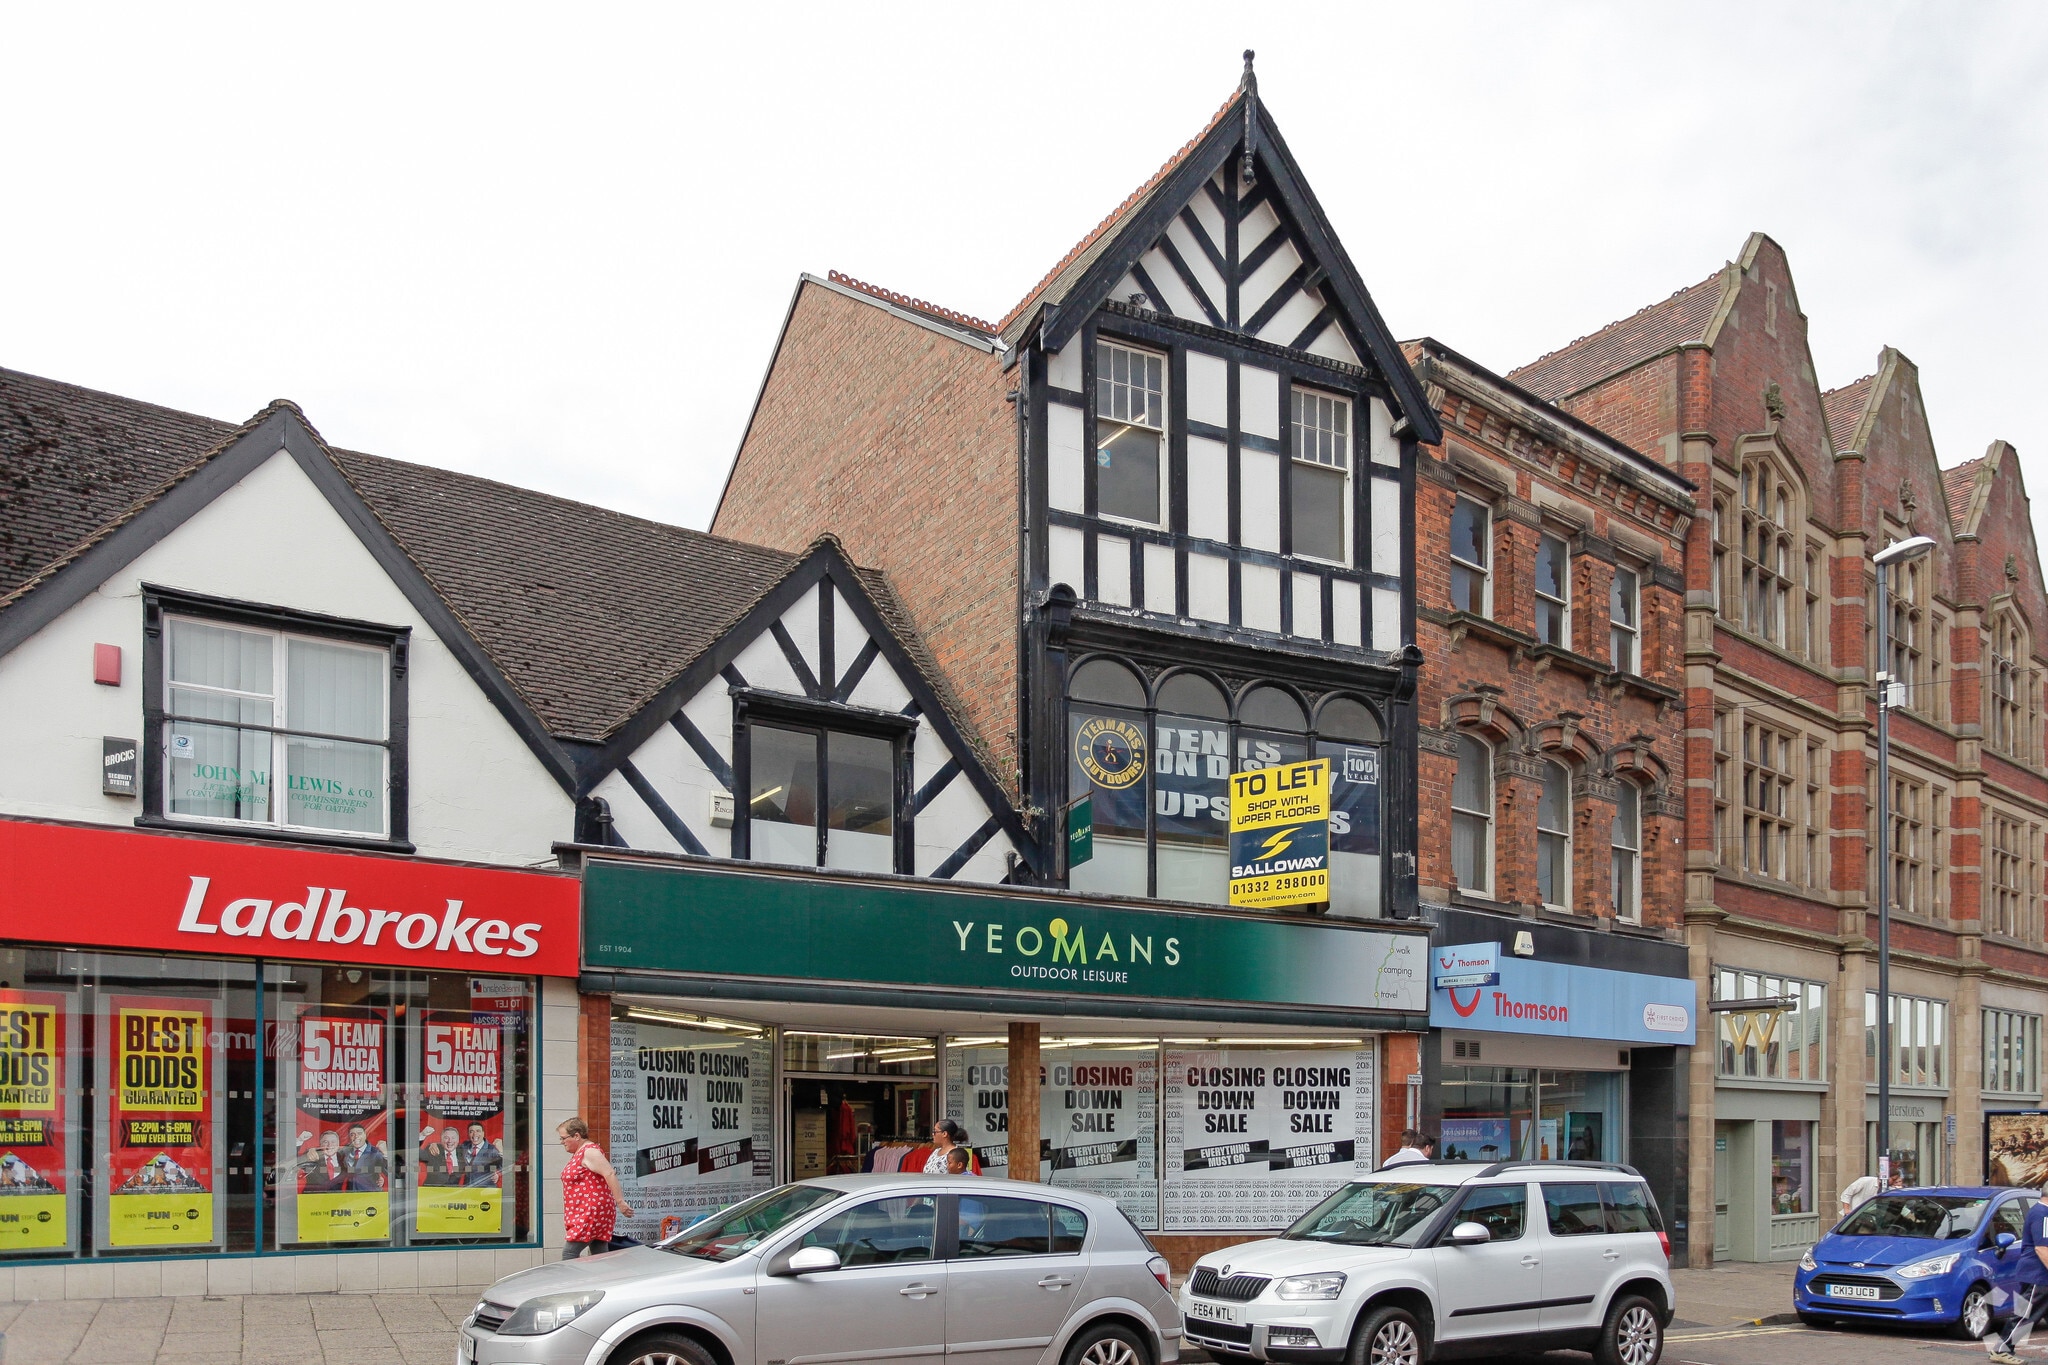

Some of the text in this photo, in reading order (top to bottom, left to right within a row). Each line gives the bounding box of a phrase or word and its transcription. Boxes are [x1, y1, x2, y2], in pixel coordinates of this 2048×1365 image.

[1082, 719, 1142, 750] YEOMANS
[105, 749, 135, 766] BROCKS
[1156, 750, 1198, 777] ON
[1349, 758, 1373, 773] 100
[108, 772, 132, 780] SECURITY
[1083, 756, 1143, 785] OUTDOORS
[1348, 773, 1375, 781] YEARS
[110, 779, 130, 787] SYSTEM
[193, 763, 376, 800] JOHN M LEWIS & CO.
[202, 782, 251, 795] LICENSED
[1234, 774, 1266, 798] TO
[1277, 764, 1324, 792] LET
[186, 788, 267, 804] CONVEYANCERS
[291, 793, 369, 808] COMMISSIONERS
[1248, 794, 1309, 812] SHOP WITH
[303, 802, 356, 815] FOR OATHS
[1237, 804, 1320, 825] UPPER FLOORS
[1232, 856, 1324, 878] SALLOWAY
[1232, 874, 1325, 895] 01332 298000
[1240, 892, 1316, 904] www.salloway.com
[178, 876, 542, 958] Ladbrokes
[599, 944, 632, 954] EST 1904
[952, 920, 1181, 966] YEOMANS
[1395, 946, 1411, 955] walk
[1383, 966, 1413, 977] camping
[1457, 959, 1490, 967] Thomson
[1011, 965, 1128, 984] OUTDOOR LEISURE
[1380, 990, 1398, 999] travel
[1492, 991, 1568, 1022] Thomson
[126, 1015, 198, 1053] BEST
[1720, 1010, 1784, 1055] W
[304, 1020, 380, 1070] 5 TEAM
[427, 1026, 498, 1073] 5 TEAM
[332, 1048, 380, 1072] ACCA
[453, 1052, 497, 1075] ACCA
[638, 1045, 695, 1074] CLOSING
[700, 1052, 749, 1079] CLOSING
[126, 1054, 198, 1089] ODDS
[968, 1065, 1047, 1086] CLOSG
[1054, 1065, 1133, 1086] CLOSING
[1187, 1067, 1265, 1087] CLOSING
[1273, 1067, 1351, 1087] CLOSING
[304, 1071, 380, 1092] INSURANCE
[427, 1074, 498, 1094] INSURANCE
[647, 1076, 688, 1101] DOWN
[126, 1089, 198, 1106] GUARANTEED
[707, 1080, 743, 1104] DOWN
[1065, 1090, 1122, 1109] DOWN
[1197, 1091, 1255, 1110] DOWN
[1283, 1091, 1340, 1110] DOWN
[653, 1105, 683, 1130] SALE
[711, 1107, 739, 1130] SALE
[1888, 1104, 1925, 1118] aterstones
[14, 1120, 42, 1131] 5-6PM
[131, 1121, 159, 1133] 12-2PM
[166, 1122, 192, 1133] 5-6PM
[985, 1112, 1009, 1133] SA
[1071, 1112, 1115, 1133] SALE
[1205, 1113, 1248, 1133] SALE
[1290, 1113, 1333, 1133] SALE
[15, 1132, 42, 1142] BETTER
[131, 1133, 192, 1143] NOW EVEN BETTER
[650, 1142, 686, 1161] EVERYTHING
[709, 1142, 741, 1160] EVERYTHING
[1067, 1142, 1118, 1158] EVERYTHING
[1075, 1152, 1113, 1167] MUST GO
[1200, 1143, 1251, 1159] EVERYTHING
[1285, 1143, 1336, 1159] EVERYTHING
[655, 1154, 682, 1172] MUST GO
[714, 1153, 738, 1169] MUST GO
[988, 1154, 1009, 1167] MUS
[1208, 1154, 1245, 1168] MUST GO
[1293, 1153, 1331, 1168] MUST GO
[147, 1211, 170, 1220] FUN
[331, 1209, 351, 1217] FUN
[1833, 1285, 1875, 1297] CK13 UCB
[1193, 1302, 1233, 1321] FE64 WTL
